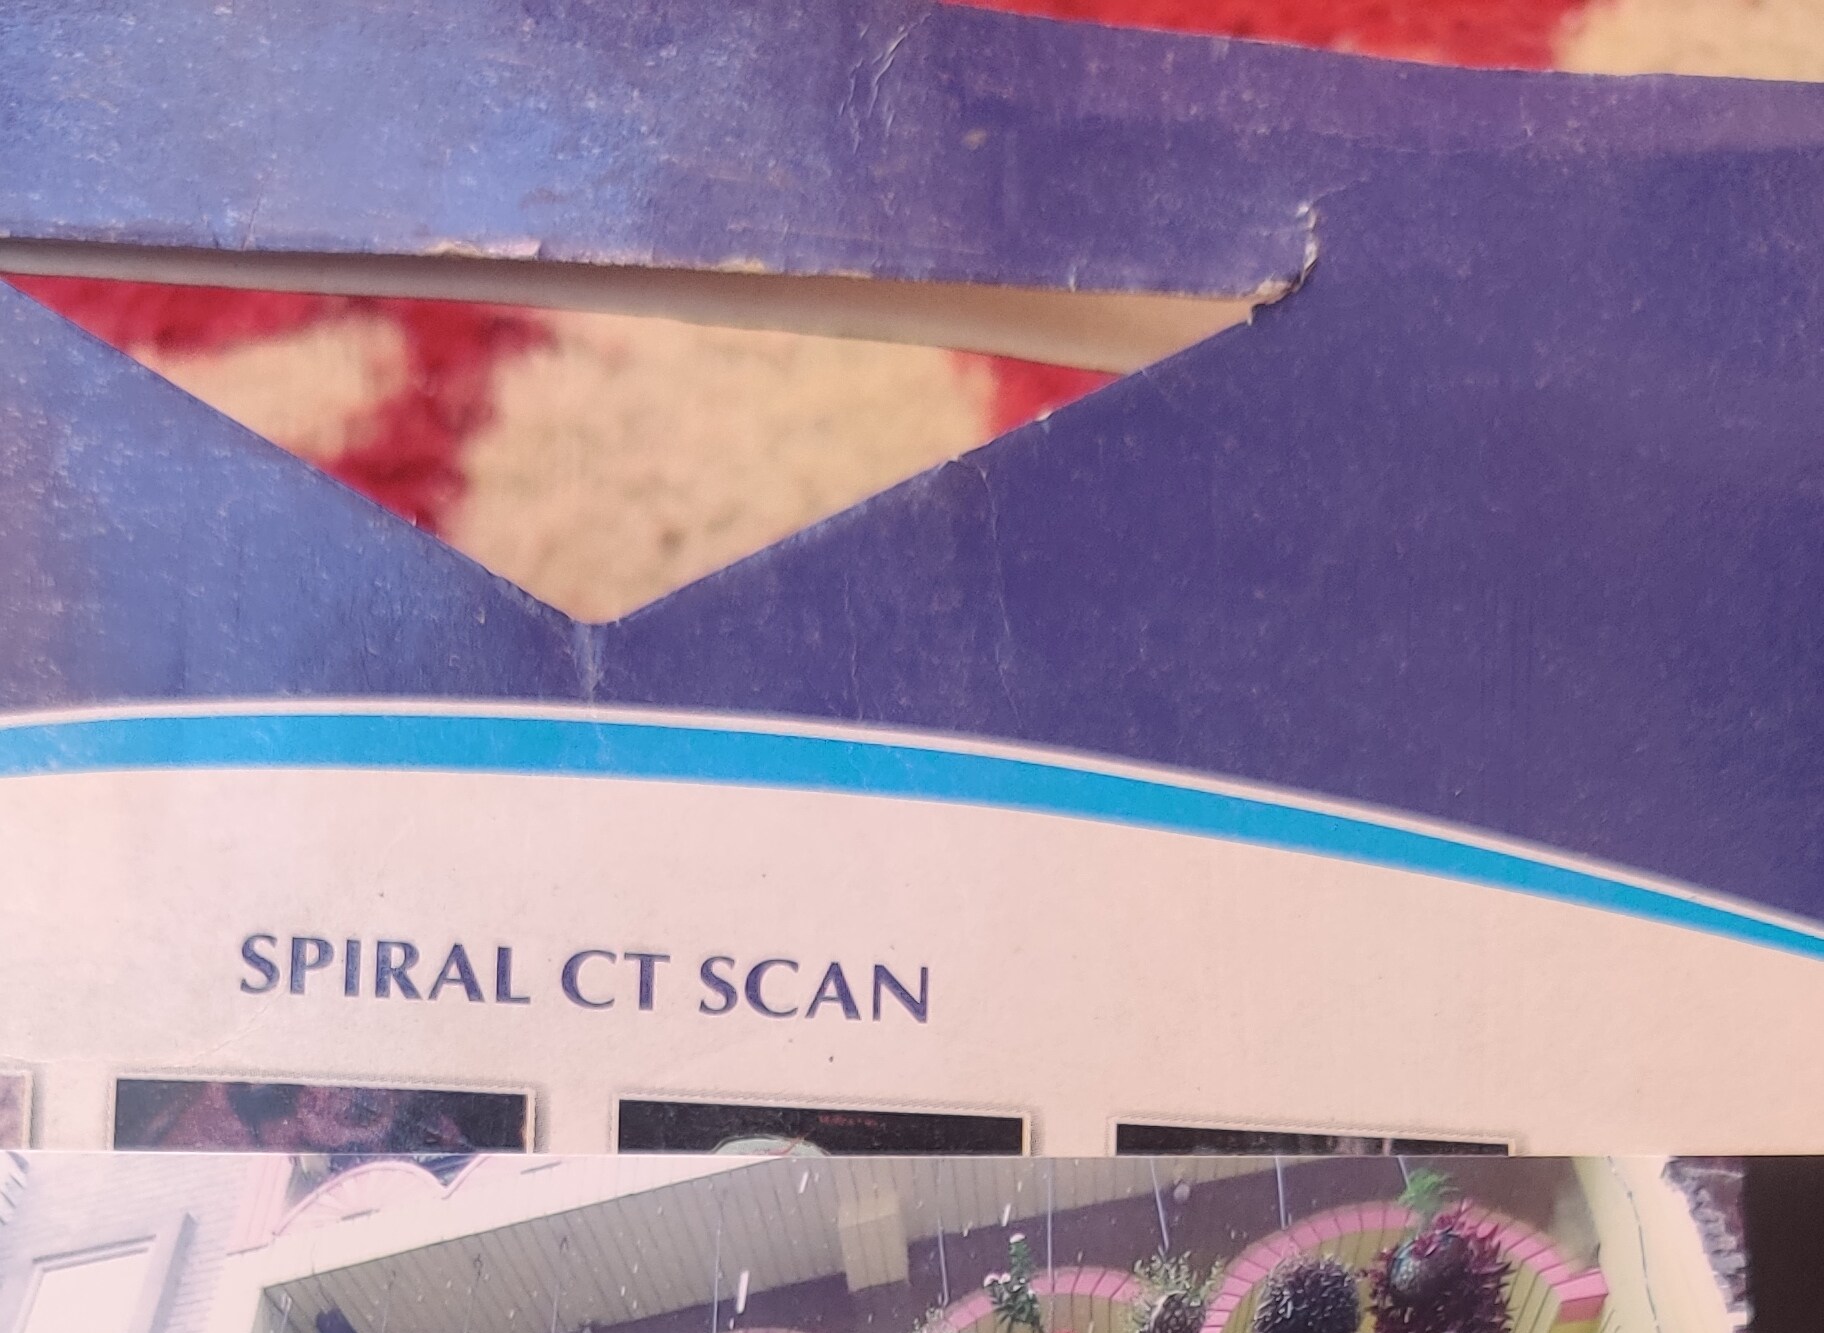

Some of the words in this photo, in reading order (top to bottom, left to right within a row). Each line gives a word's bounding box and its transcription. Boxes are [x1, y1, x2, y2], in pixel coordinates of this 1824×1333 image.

[239, 933, 531, 1005] SPIRAL
[561, 949, 671, 1012] CT
[697, 955, 929, 1024] SCAN
